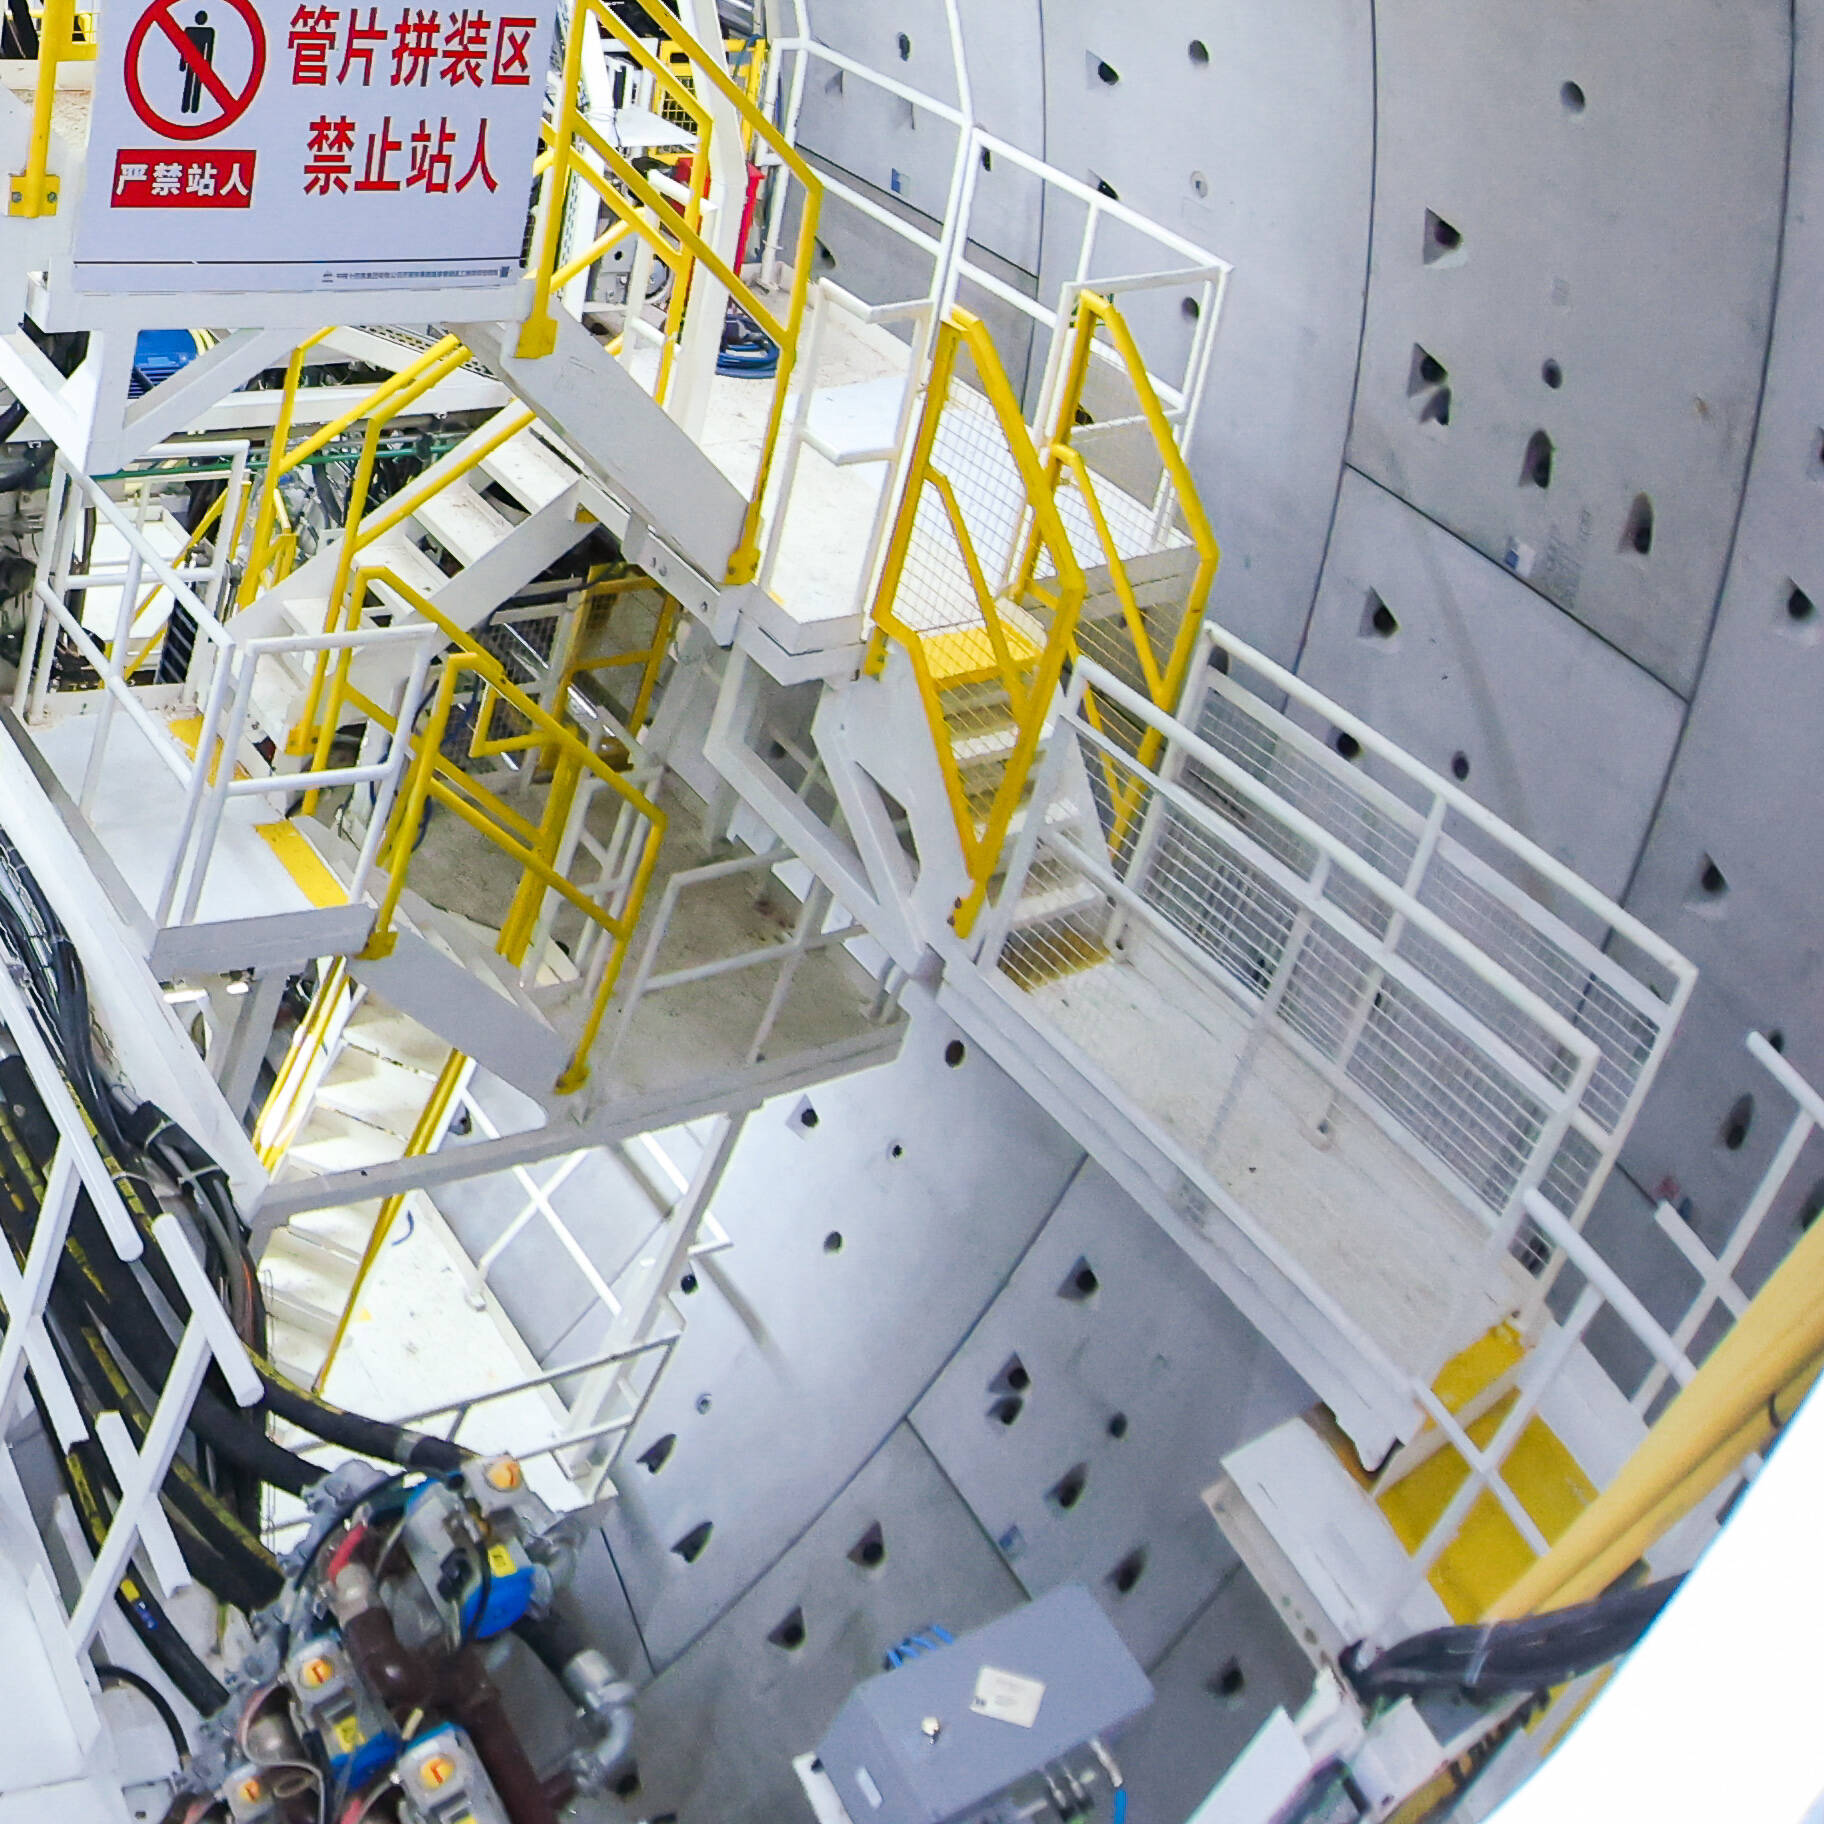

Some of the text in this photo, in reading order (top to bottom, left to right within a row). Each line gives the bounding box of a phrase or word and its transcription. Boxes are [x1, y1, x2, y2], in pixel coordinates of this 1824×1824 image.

[287, 4, 537, 88] 管片拼装区
[116, 162, 250, 197] 严禁站人
[303, 115, 499, 195] 禁止站人
